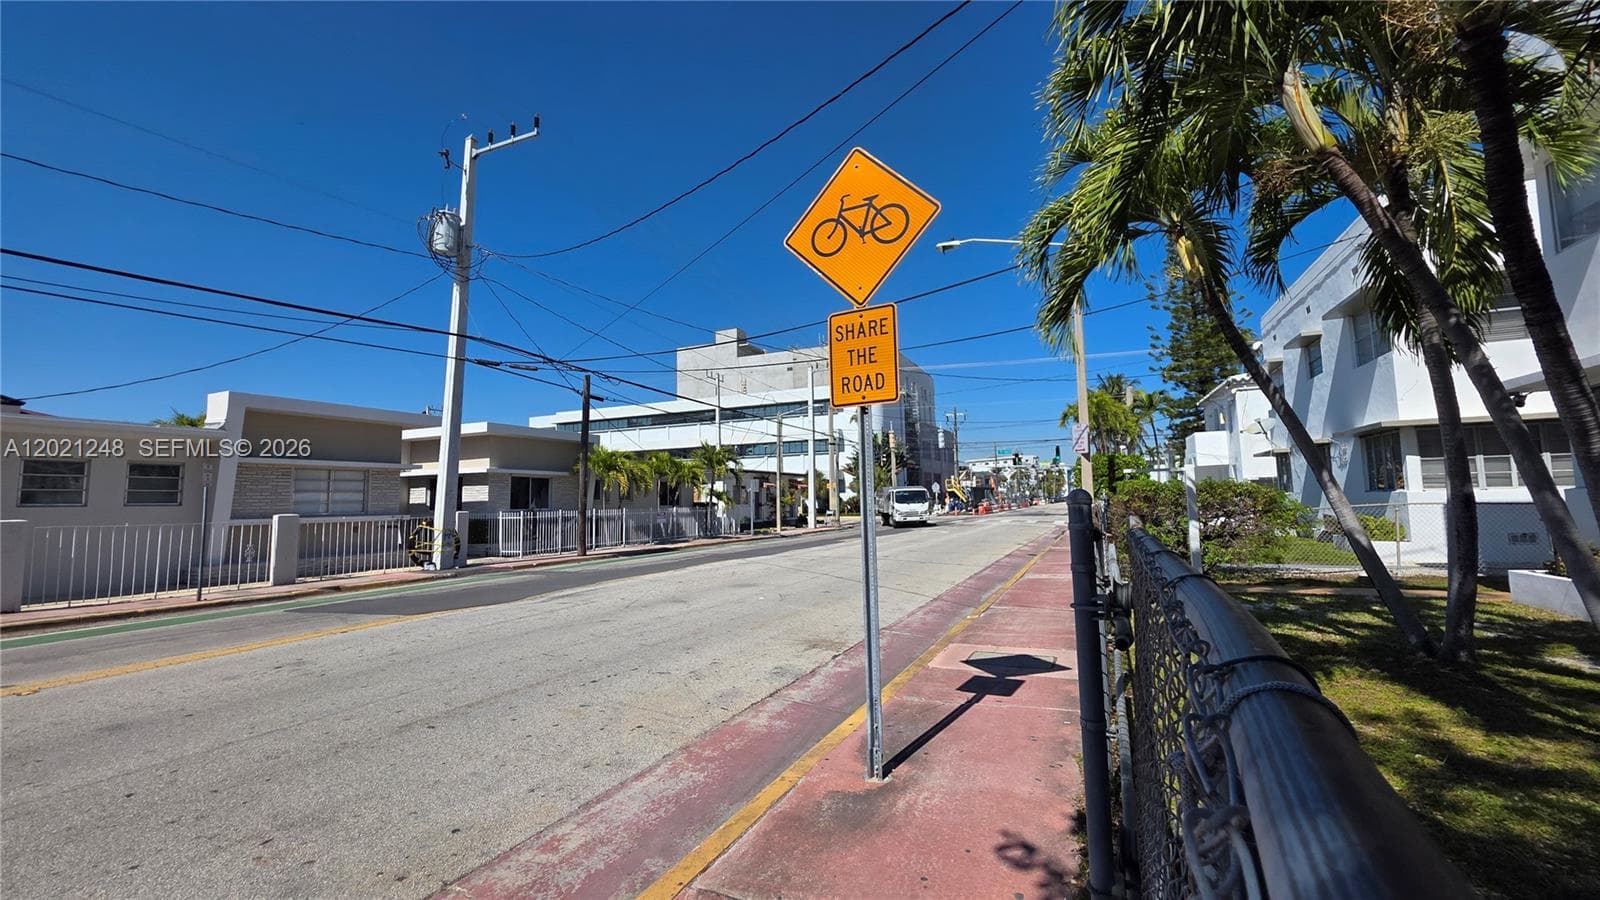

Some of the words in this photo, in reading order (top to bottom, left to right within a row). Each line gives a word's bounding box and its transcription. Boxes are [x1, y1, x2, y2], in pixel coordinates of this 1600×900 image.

[835, 317, 889, 342] SHARE
[847, 346, 878, 366] THE
[841, 372, 885, 394] ROAD
